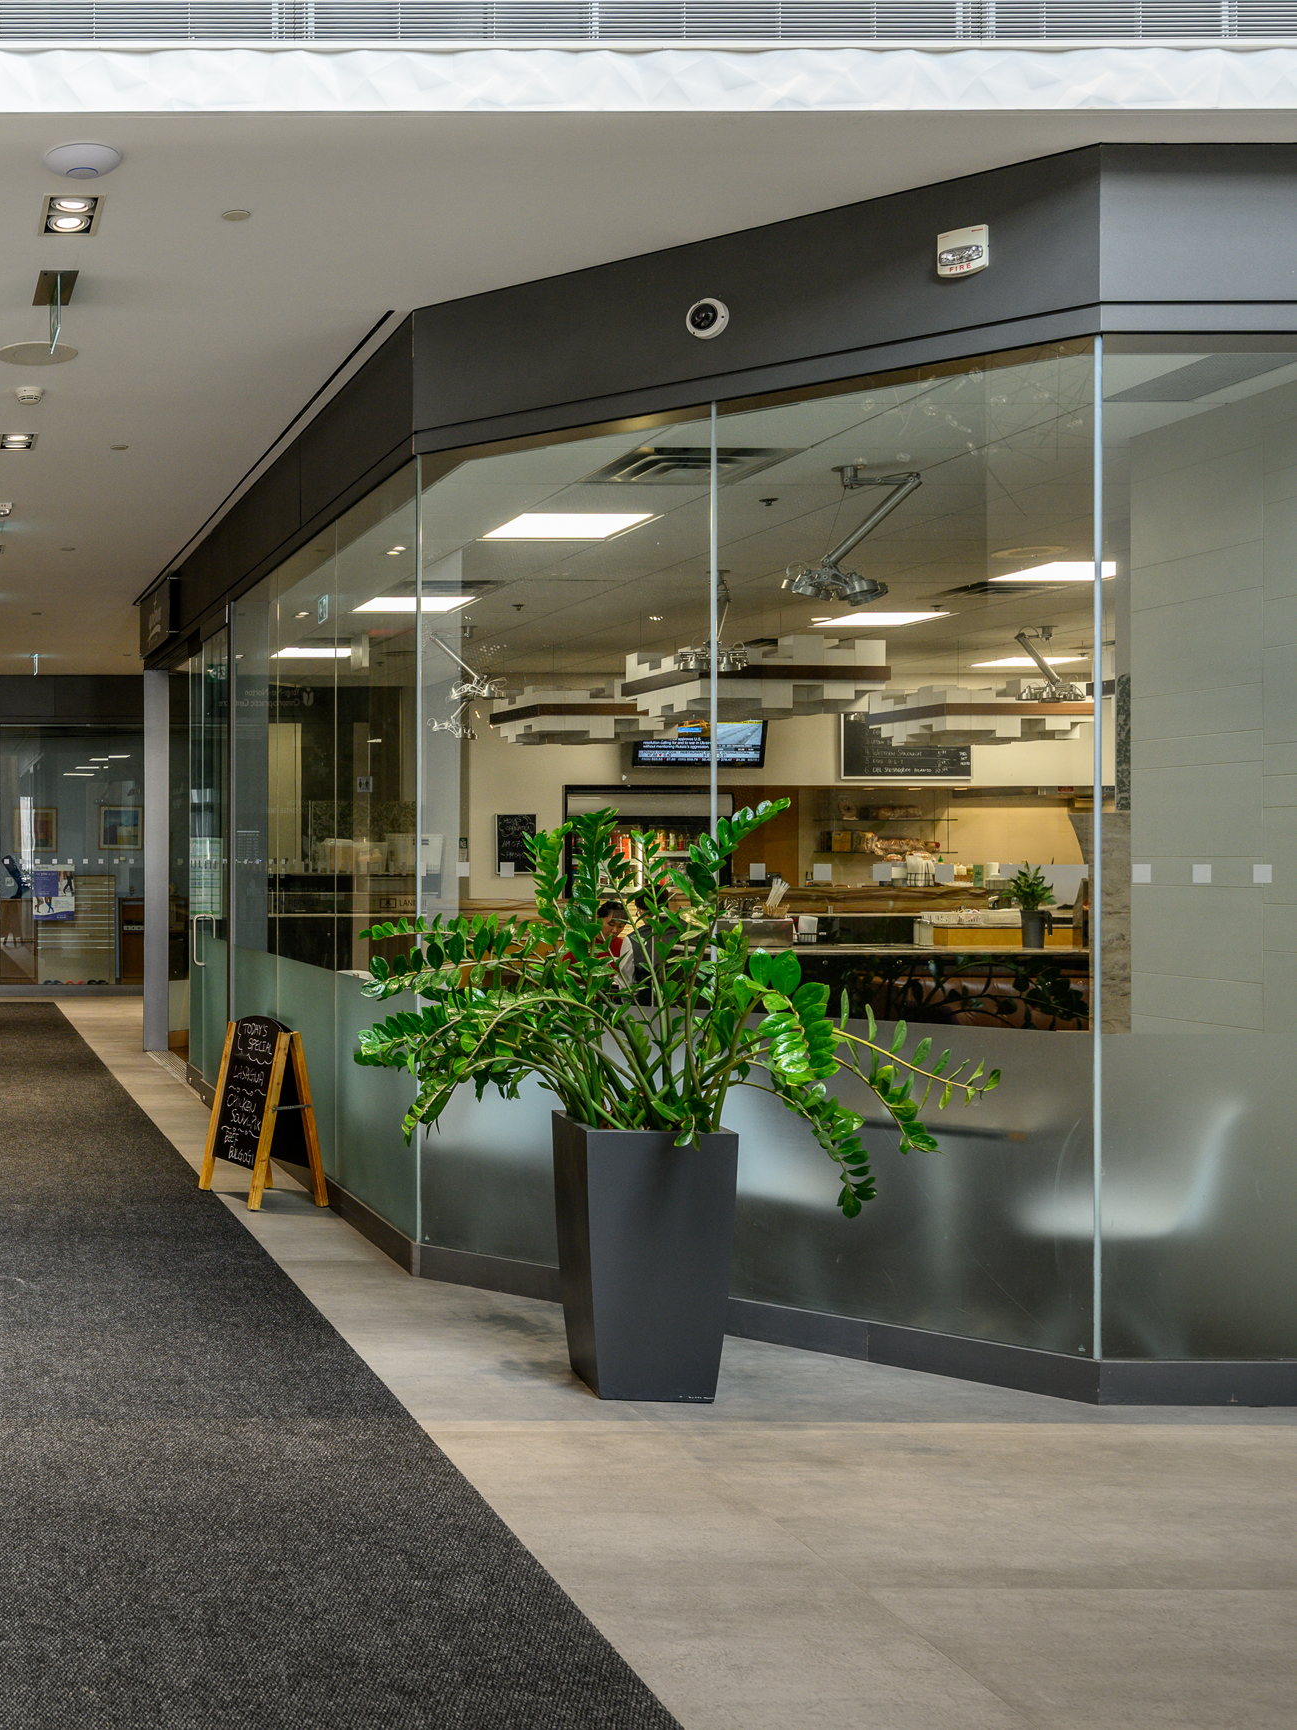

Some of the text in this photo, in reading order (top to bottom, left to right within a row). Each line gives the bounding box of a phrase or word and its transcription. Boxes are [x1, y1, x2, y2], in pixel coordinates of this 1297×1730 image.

[949, 262, 972, 273] FIRE
[288, 899, 321, 907] RECYCLE
[242, 1022, 269, 1038] TODAY'S
[247, 1037, 273, 1056] SPECIAL
[233, 1064, 265, 1087] LASAGNA
[227, 1093, 257, 1113] CHICKEN
[224, 1130, 240, 1146] BEEF
[228, 1145, 255, 1166] BULGOGI
